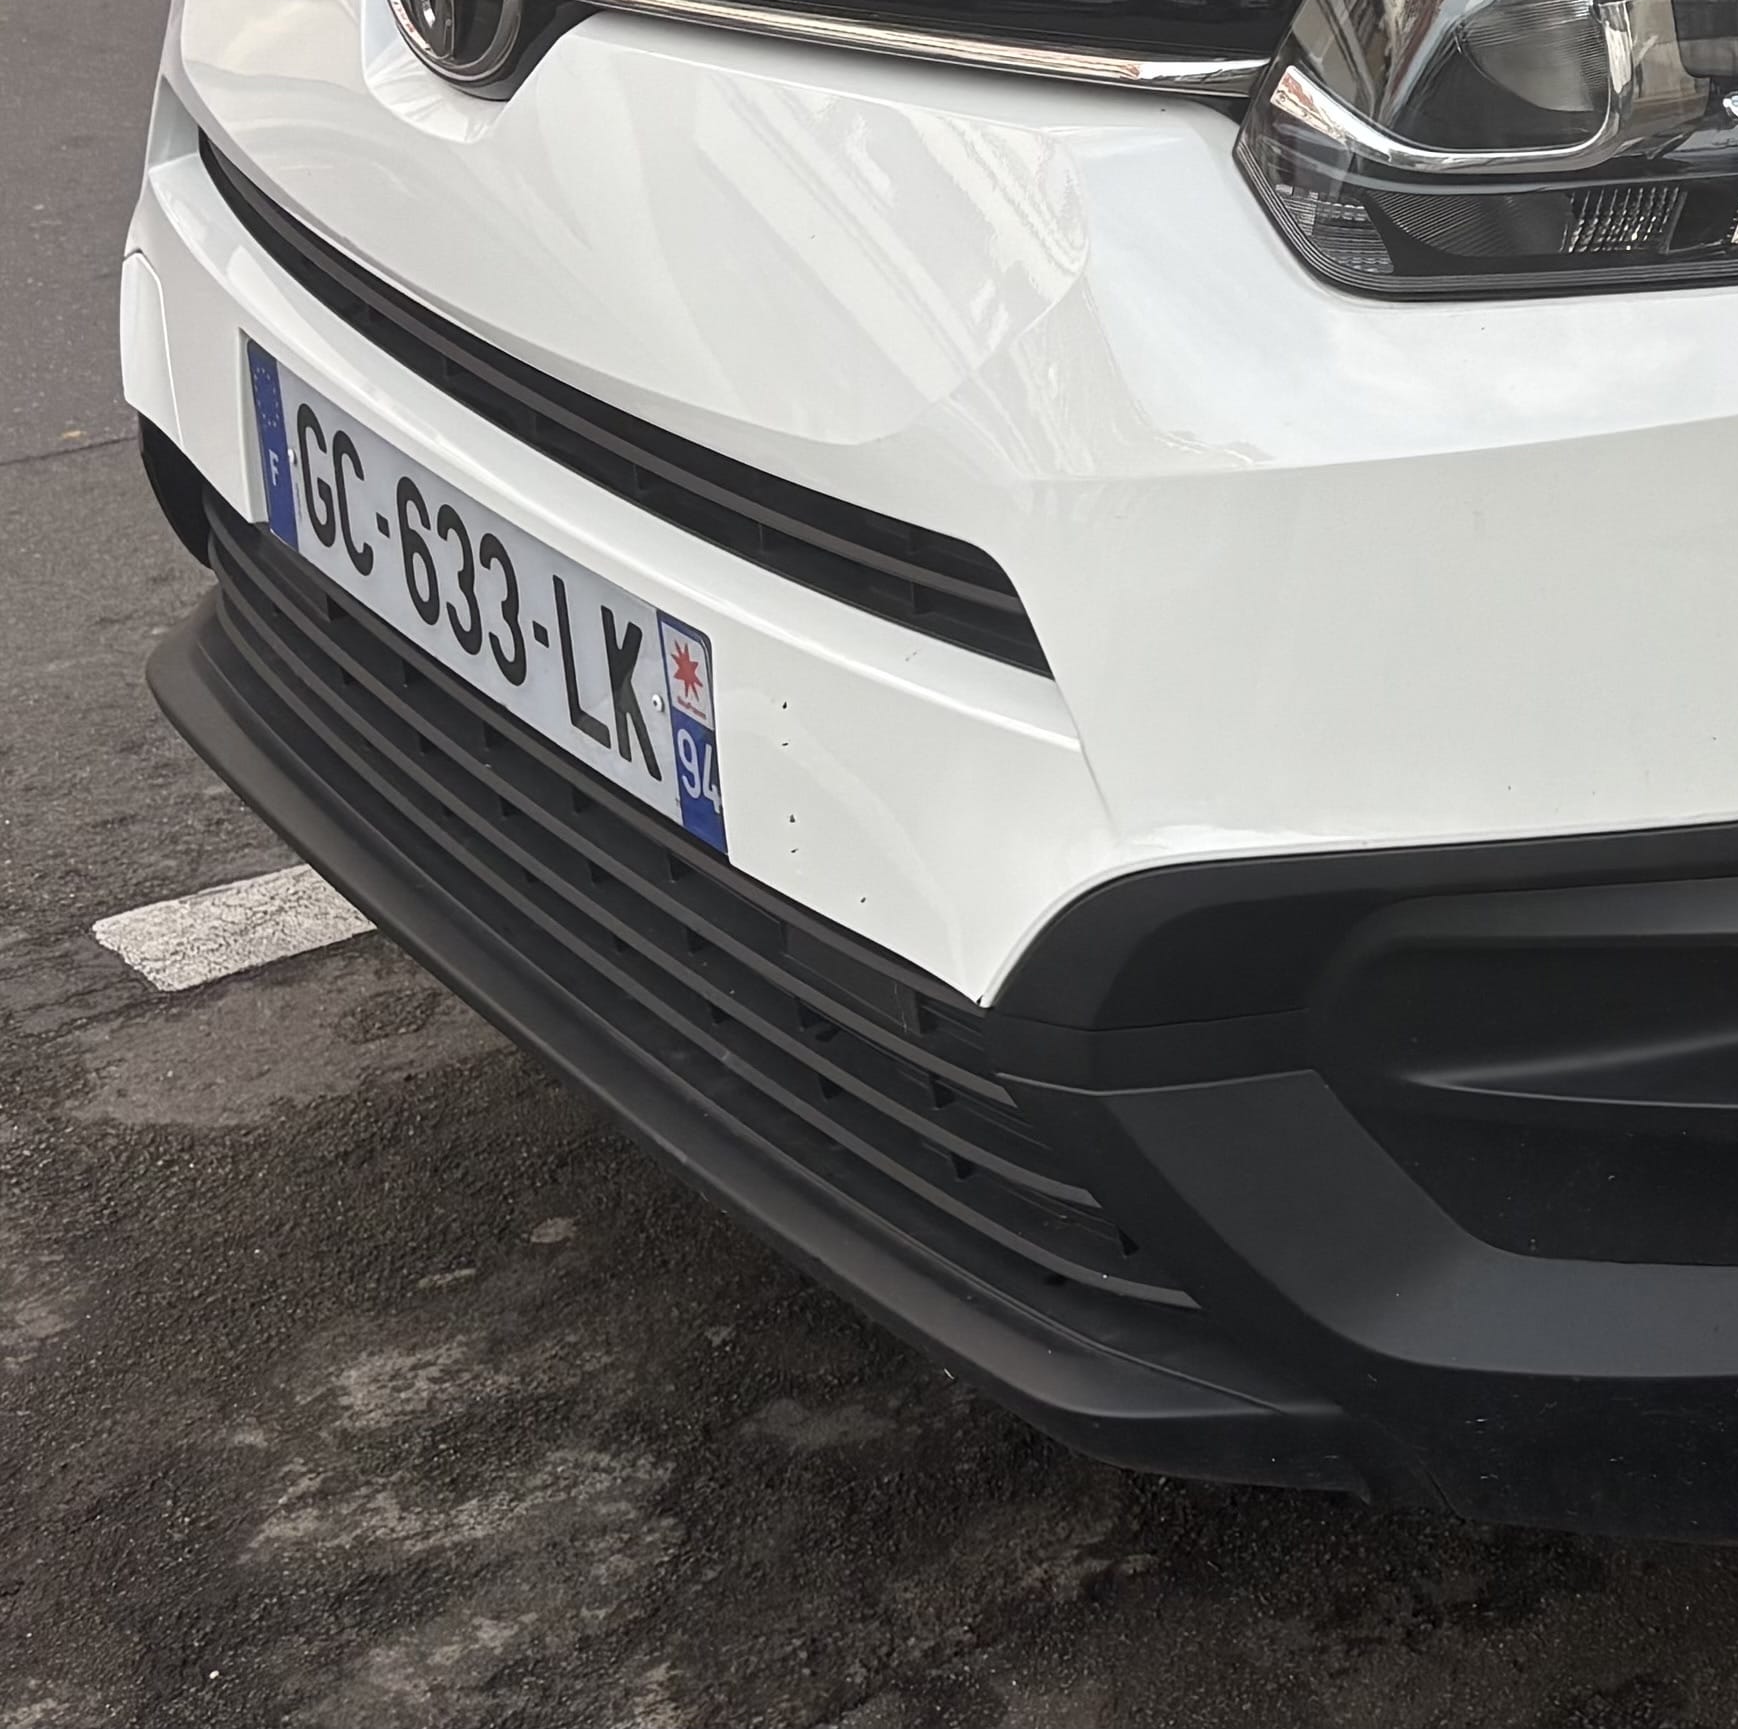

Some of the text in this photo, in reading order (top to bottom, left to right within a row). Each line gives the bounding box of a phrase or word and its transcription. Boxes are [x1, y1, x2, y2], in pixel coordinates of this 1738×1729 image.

[268, 448, 280, 487] F
[296, 403, 663, 781] GC-633-LK
[677, 728, 721, 814] 94
